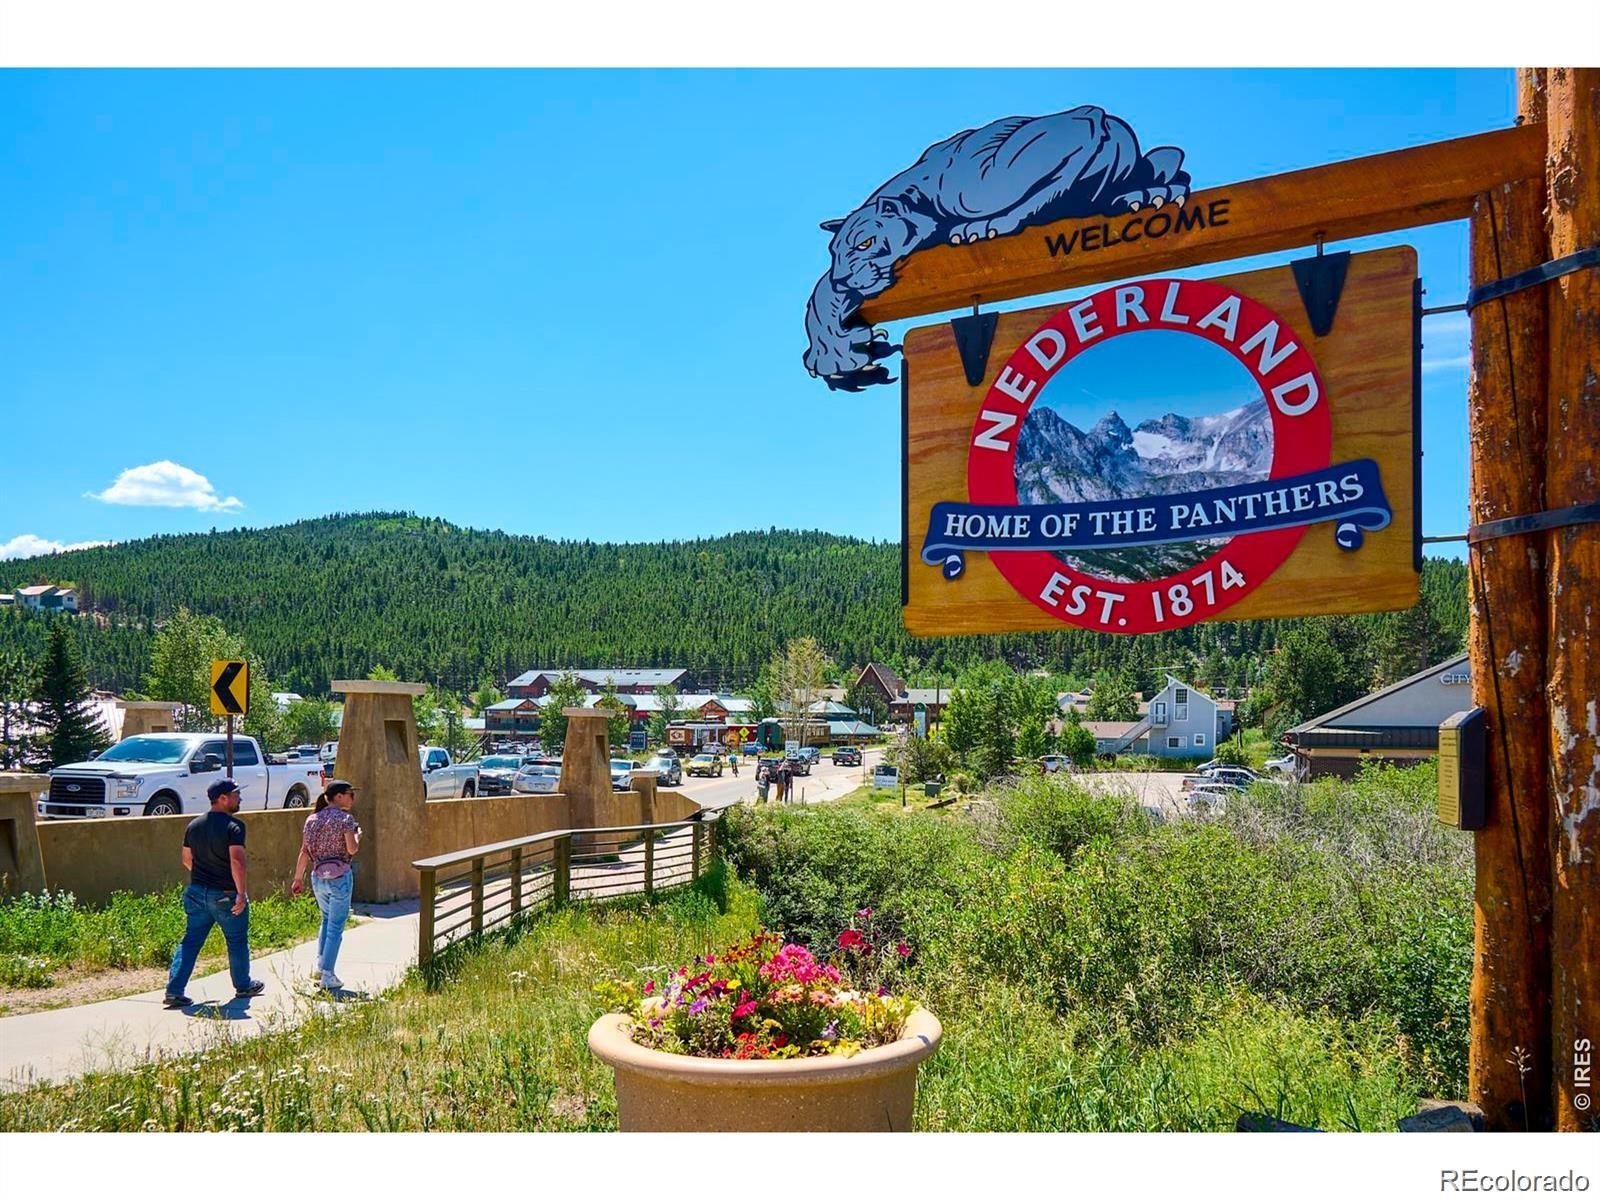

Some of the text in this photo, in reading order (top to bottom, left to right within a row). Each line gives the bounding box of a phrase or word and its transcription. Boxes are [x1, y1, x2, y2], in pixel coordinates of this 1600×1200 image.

[1044, 199, 1230, 257] WELCOME
[974, 281, 1320, 453] NEDERLAND
[944, 473, 1365, 539] HOME OF THE PANTHERS
[1039, 559, 1247, 627] EST. 1874
[1440, 672, 1471, 685] CITY
